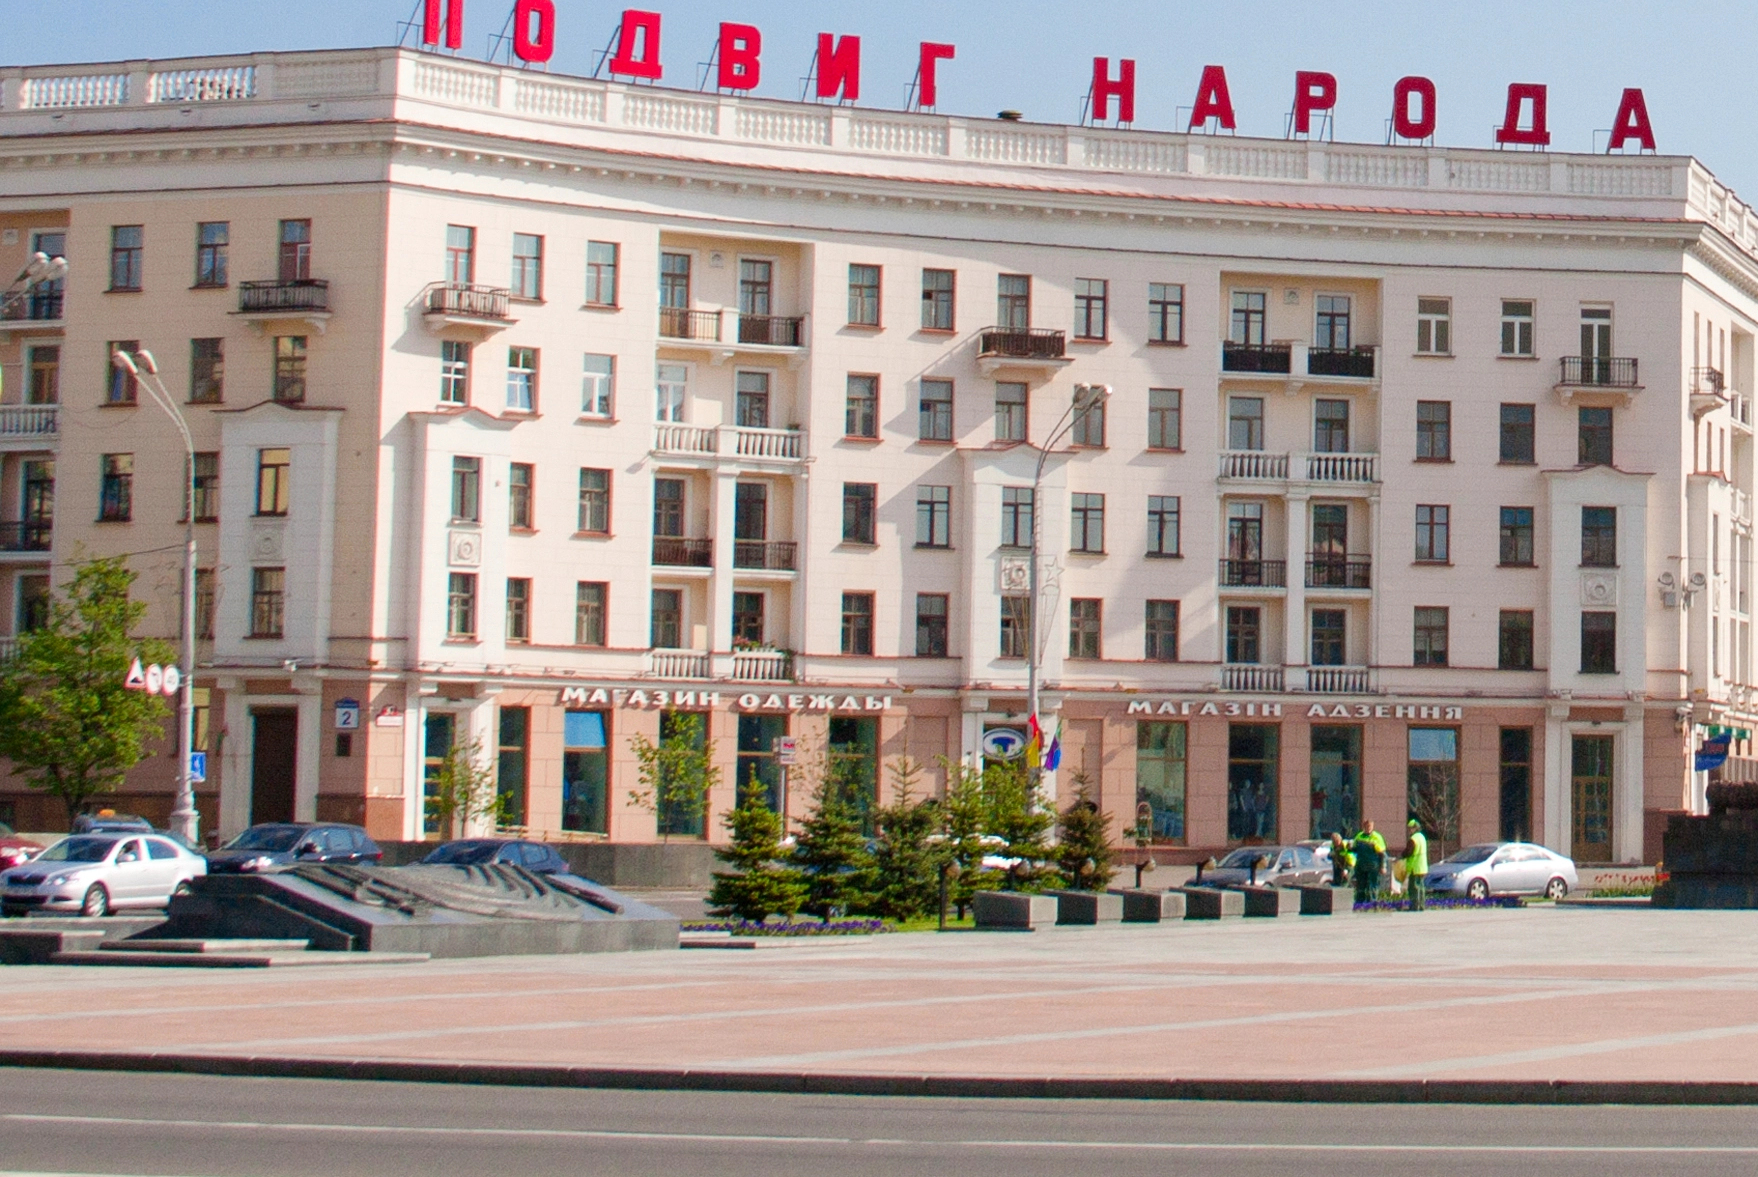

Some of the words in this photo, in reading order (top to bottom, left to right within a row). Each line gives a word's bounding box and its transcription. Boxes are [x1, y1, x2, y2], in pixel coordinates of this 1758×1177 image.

[1092, 56, 1656, 149] НАРОДА
[561, 686, 720, 706] МАГАЗИН
[738, 693, 892, 711] ОДЕЖДЫ
[342, 711, 351, 726] 2
[1127, 700, 1282, 717] МАГАЗІН
[1306, 703, 1463, 720] АДЗЕННЯ
